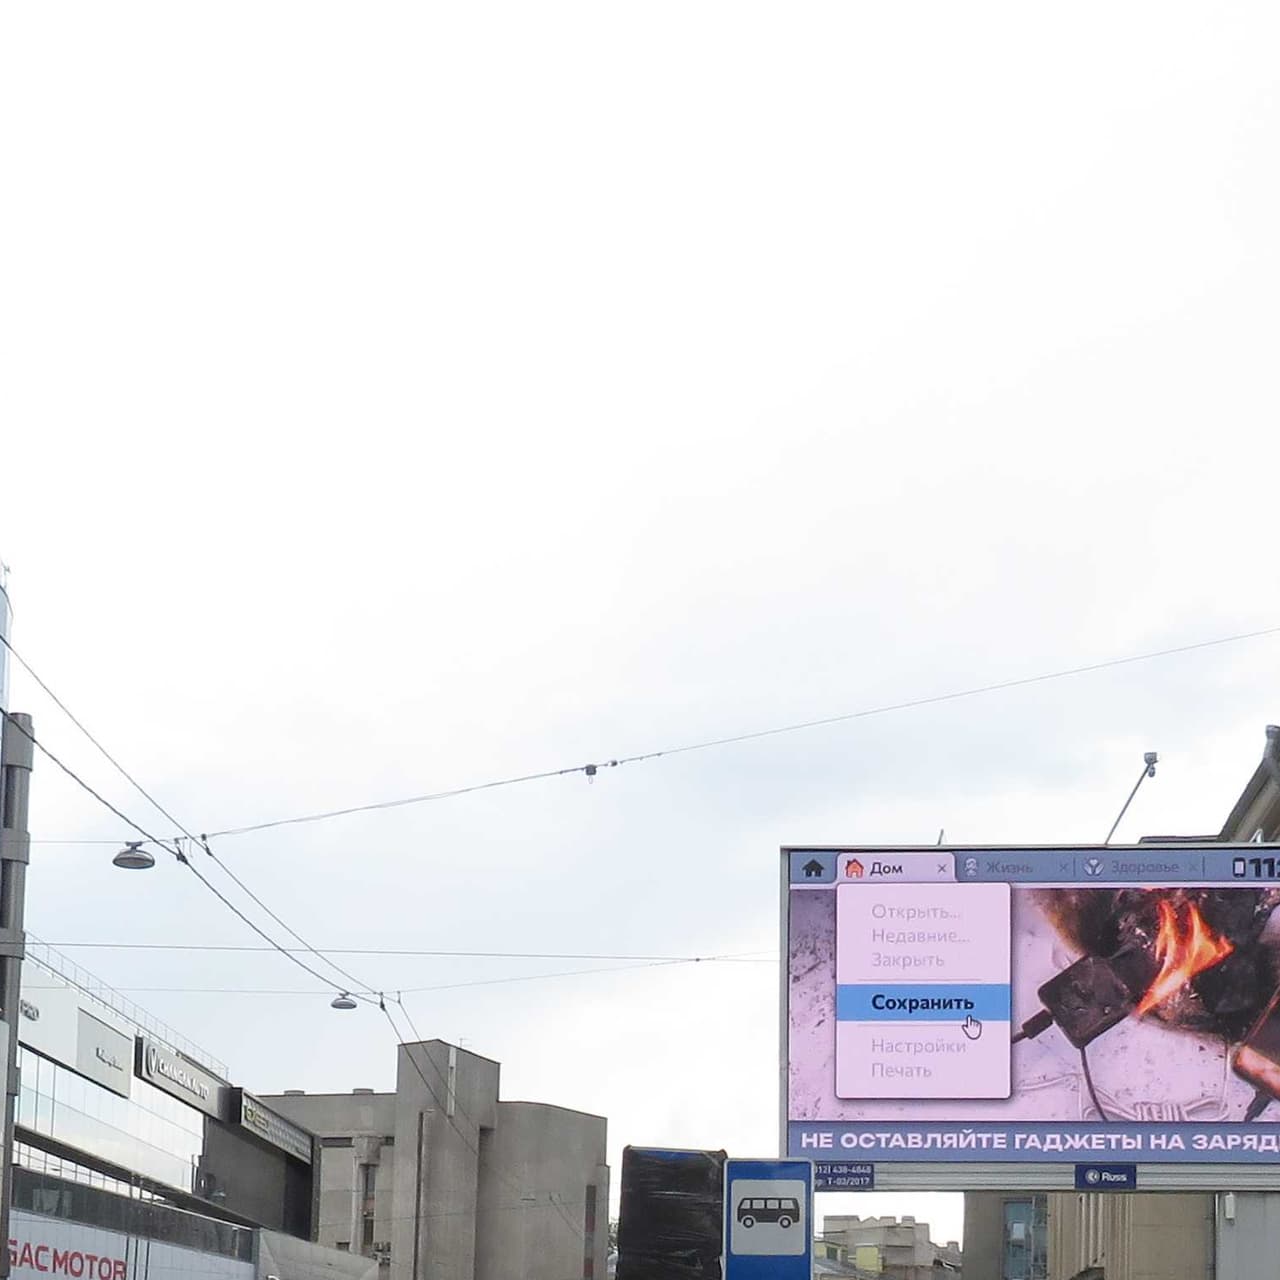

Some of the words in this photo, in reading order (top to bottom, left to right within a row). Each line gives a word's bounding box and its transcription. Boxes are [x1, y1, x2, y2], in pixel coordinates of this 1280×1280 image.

[870, 862, 903, 876] Дом
[986, 861, 1033, 873] Жизнь
[1111, 861, 1180, 875] Здоровье
[872, 952, 944, 970] Закрыть
[871, 994, 975, 1013] Сохранить
[872, 1038, 967, 1057] Настройки
[872, 1063, 933, 1078] Печать
[801, 1133, 833, 1148] НЕ
[840, 1128, 1007, 1149] ОСТАВЛЯЙТЕ
[1015, 1133, 1142, 1151] ГАДЖЕТЫ
[1150, 1134, 1185, 1150] НА
[1101, 1172, 1127, 1182] Russ
